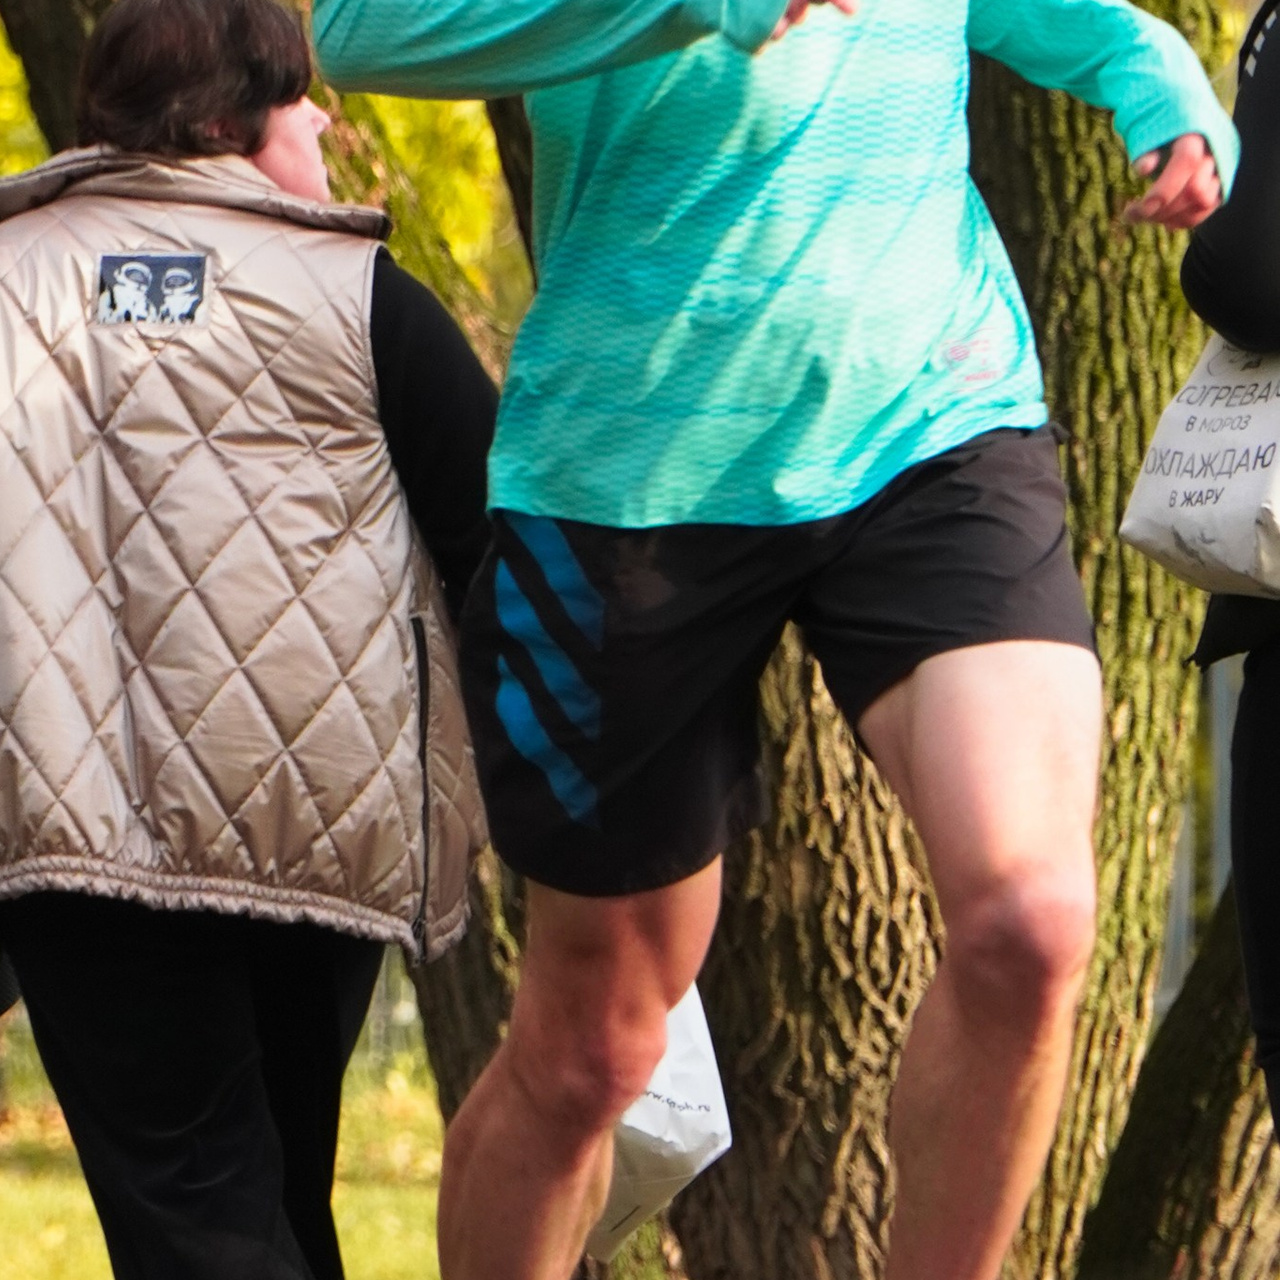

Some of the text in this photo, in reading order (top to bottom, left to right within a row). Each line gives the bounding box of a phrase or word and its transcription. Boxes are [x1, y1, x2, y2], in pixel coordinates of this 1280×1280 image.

[1185, 414, 1252, 433] В МОРОЗ
[1144, 442, 1277, 480] ОХЛАЖДАЮ
[1168, 487, 1226, 508] В ЖАРУ
